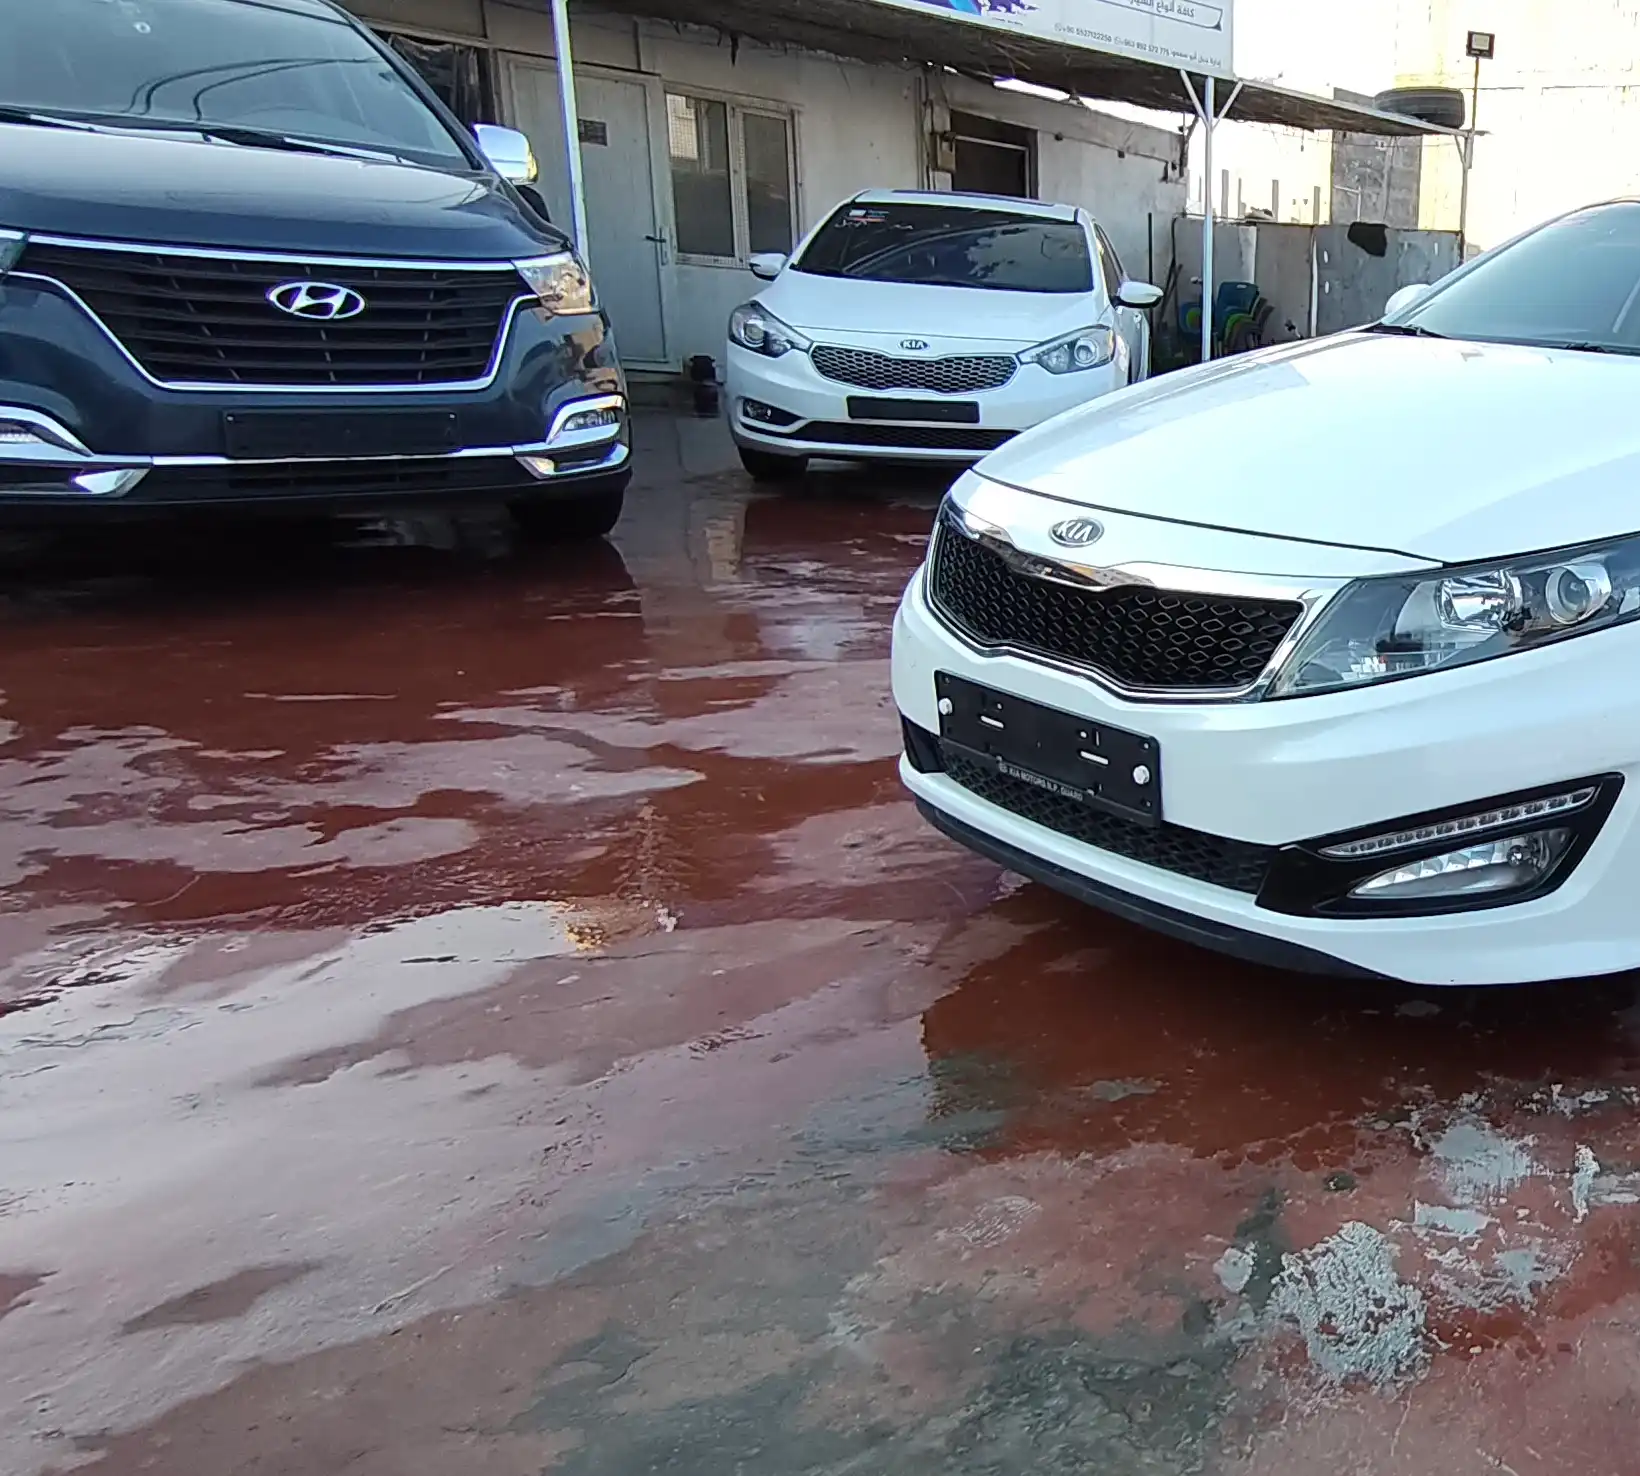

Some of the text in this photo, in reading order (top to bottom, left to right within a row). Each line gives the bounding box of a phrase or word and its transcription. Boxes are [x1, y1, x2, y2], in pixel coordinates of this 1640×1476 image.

[1176, 5, 1195, 18] كافة
[903, 339, 924, 349] KIA
[1056, 520, 1094, 542] KIA
[1009, 767, 1020, 778] KIA
